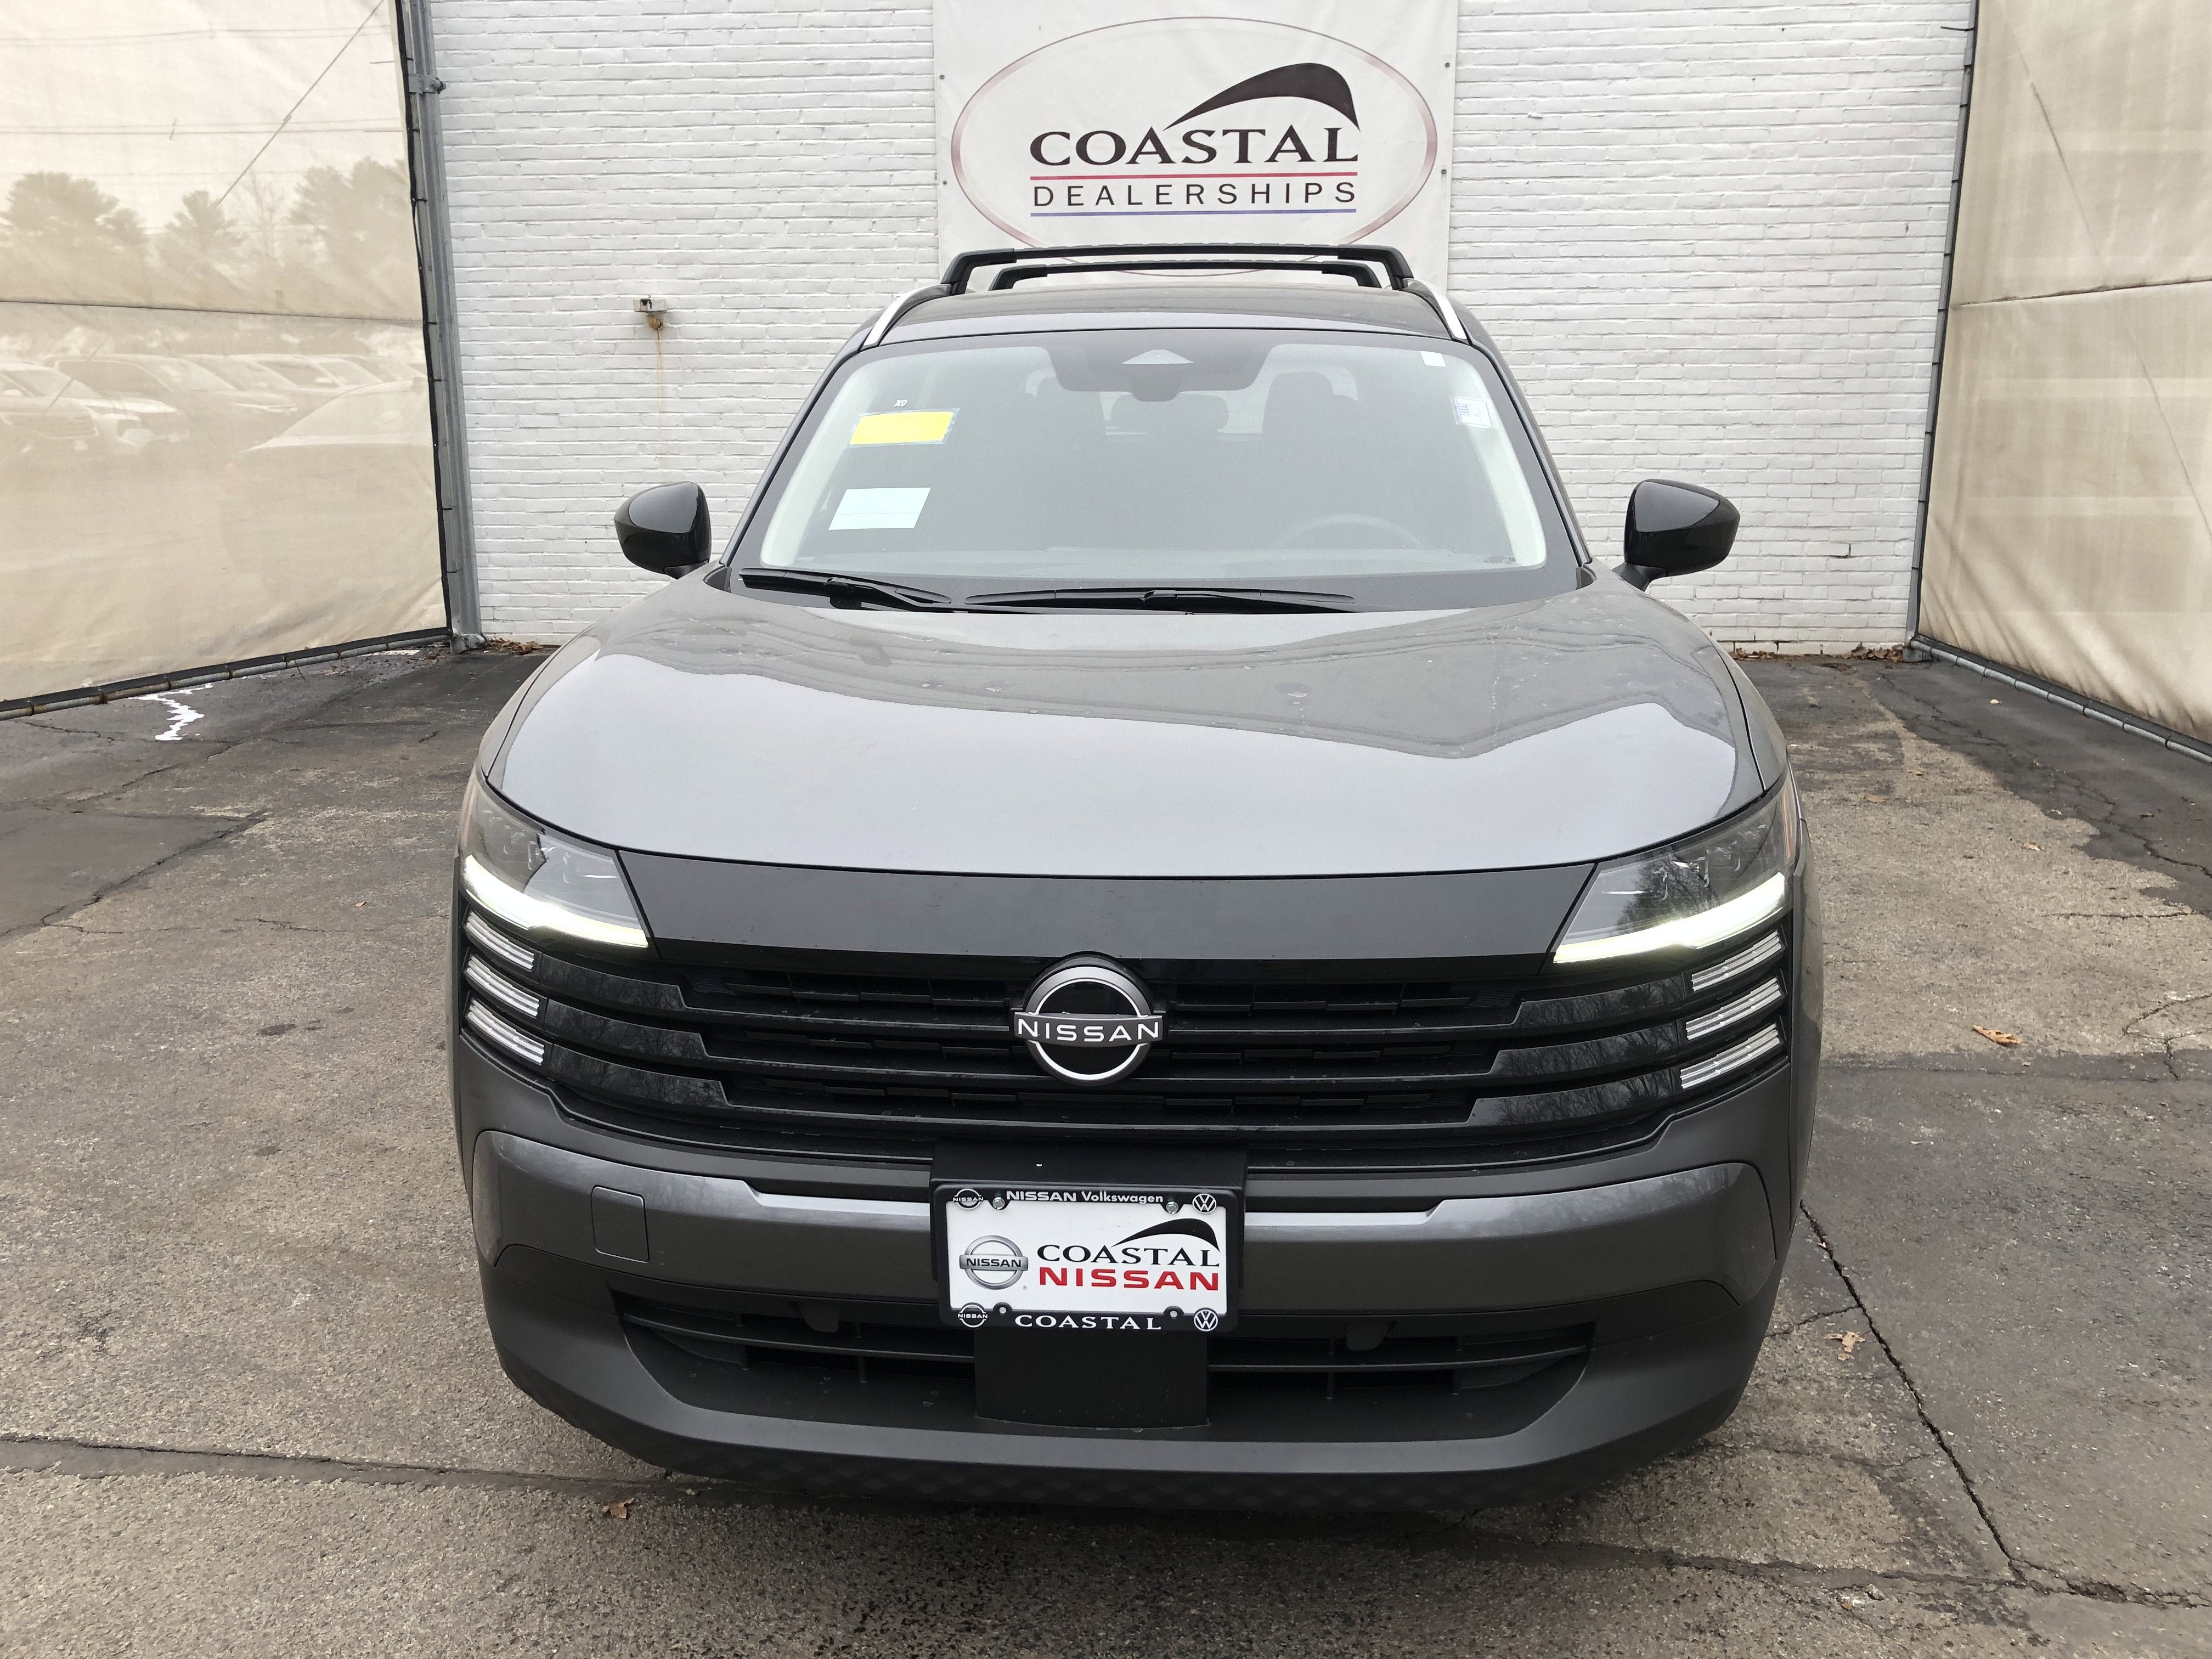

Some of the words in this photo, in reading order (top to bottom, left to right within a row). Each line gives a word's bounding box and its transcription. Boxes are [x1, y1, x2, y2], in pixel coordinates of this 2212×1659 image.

[1030, 125, 1358, 166] COASTAL
[1034, 182, 1355, 207] DEALERSHIPS
[1018, 1018, 1159, 1042] NISSAN
[1006, 1190, 1077, 1201] NISSAN
[1081, 1190, 1164, 1204] Volkswagen
[966, 1257, 1022, 1268] NISSAN
[1037, 1244, 1220, 1267] COASTAL
[1039, 1267, 1218, 1291] NISSAN
[1015, 1314, 1161, 1330] COASTAL
